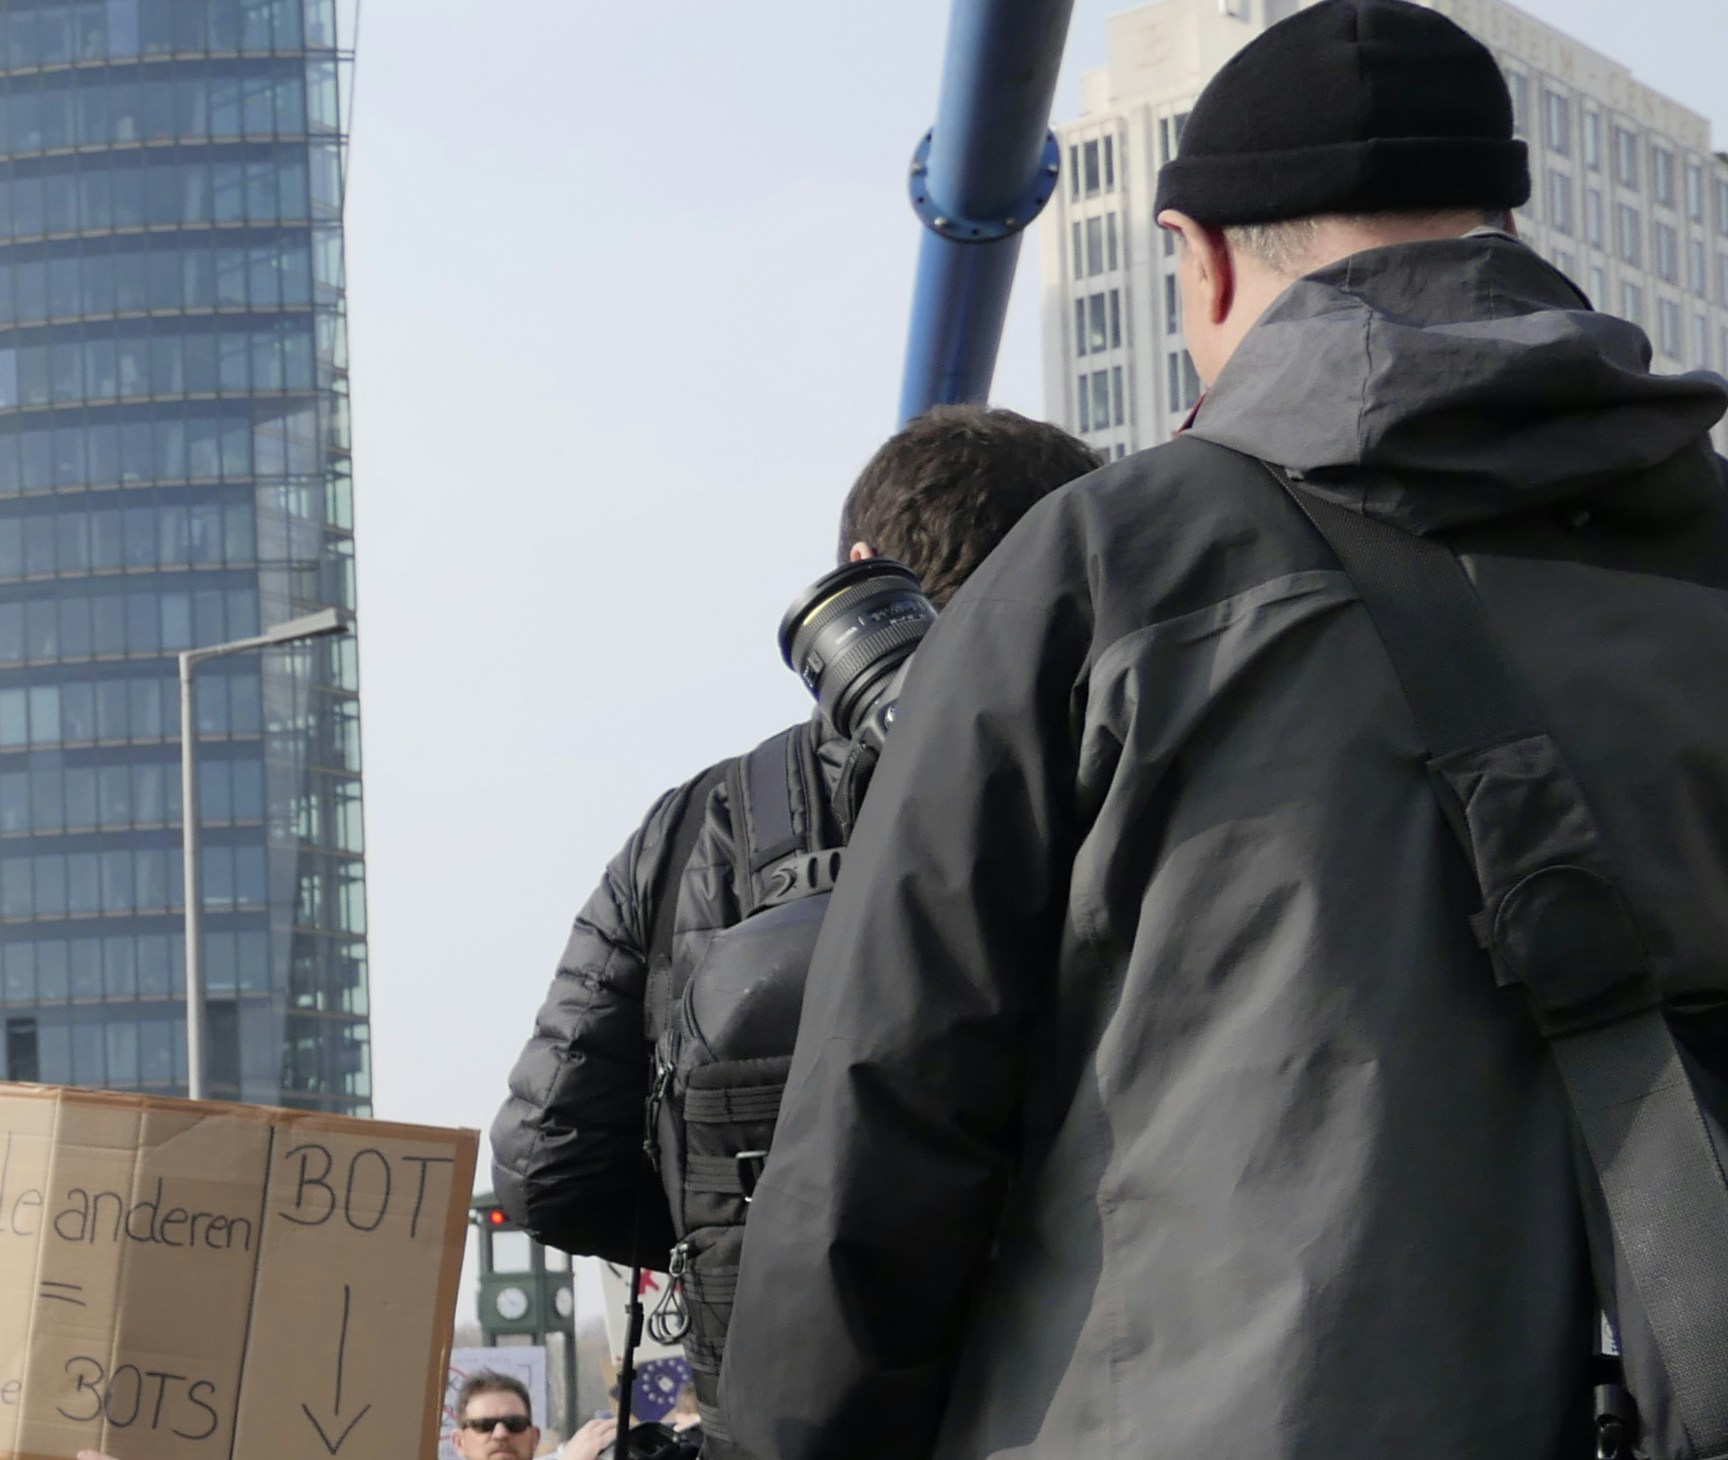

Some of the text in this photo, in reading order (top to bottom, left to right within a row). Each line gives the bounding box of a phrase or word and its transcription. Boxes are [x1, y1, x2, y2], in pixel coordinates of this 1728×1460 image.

[53, 1177, 253, 1251] anderen
[278, 1144, 455, 1239] BOT
[57, 1355, 219, 1441] BOTS
